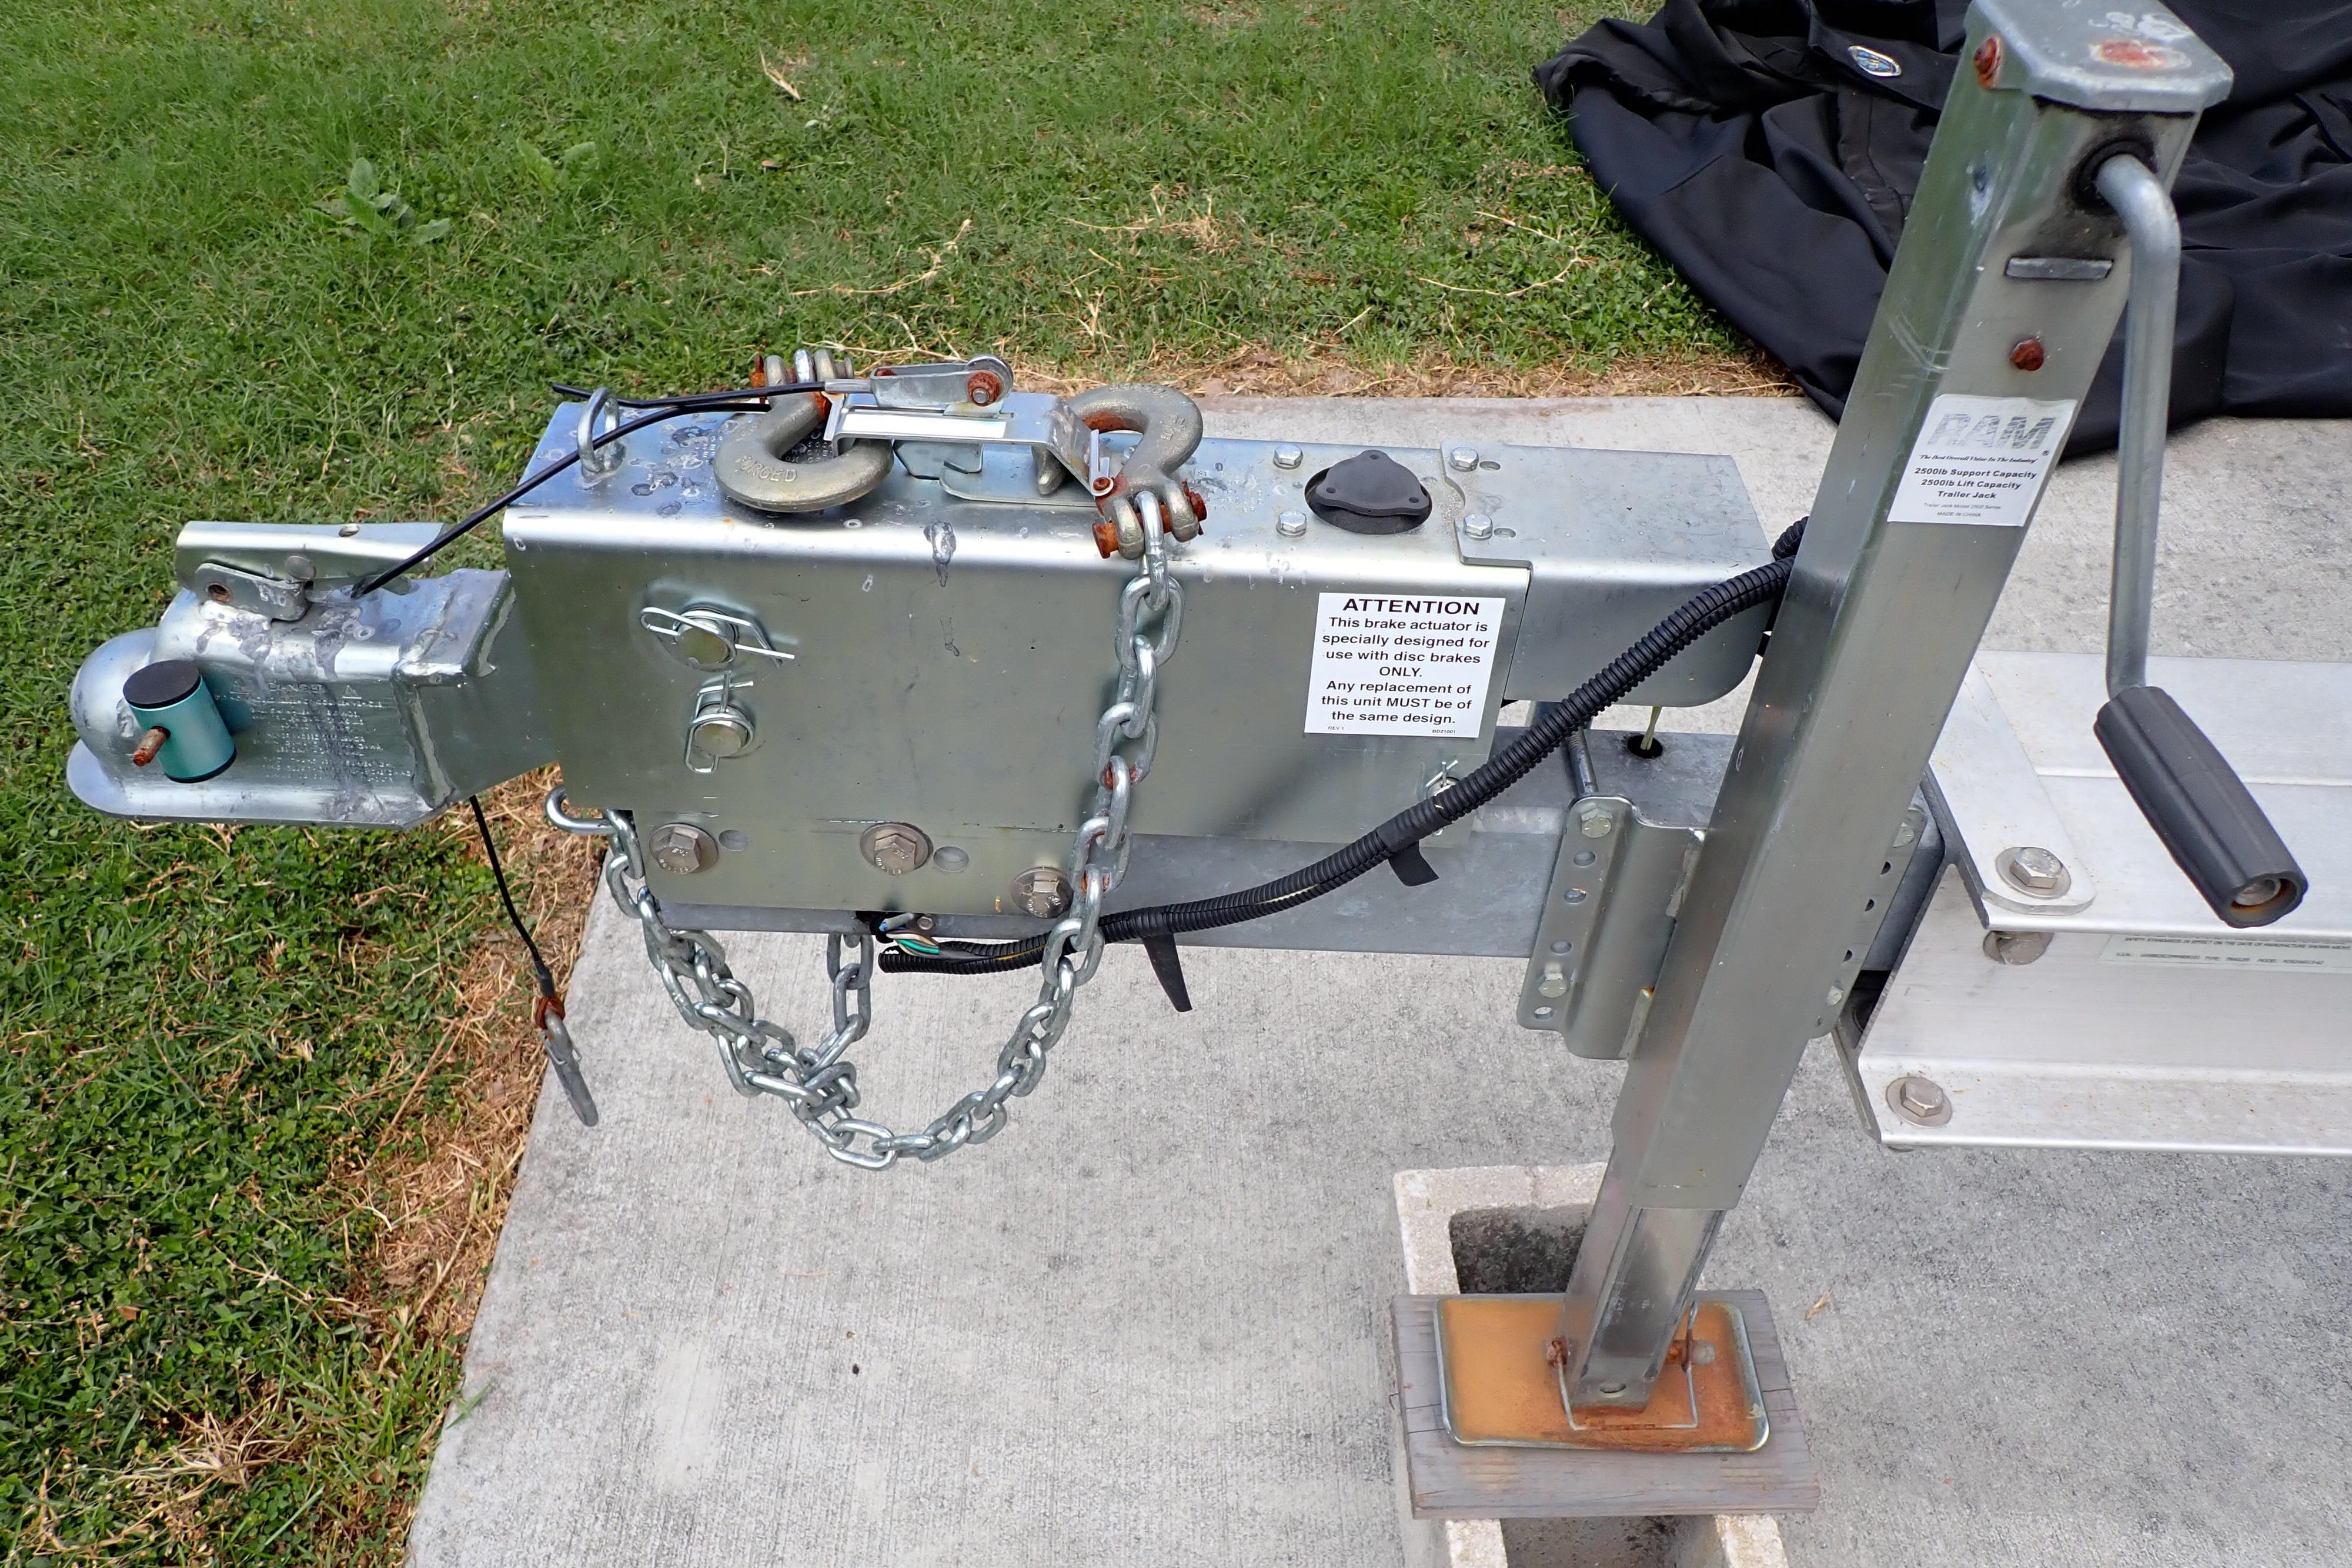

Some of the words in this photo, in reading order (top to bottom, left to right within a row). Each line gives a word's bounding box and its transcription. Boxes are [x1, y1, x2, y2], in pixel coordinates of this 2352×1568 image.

[1915, 467, 1947, 476] 2500lb
[1950, 469, 1990, 477] Support
[1993, 470, 2037, 480] Capacity
[1920, 479, 1955, 487] 2500lb
[1977, 481, 2022, 490] Capacity
[1342, 598, 1480, 616] ATTENTION
[1329, 617, 1360, 628] This
[1364, 618, 1406, 630] brake
[1410, 620, 1472, 632] actuator
[1475, 621, 1488, 632] is
[1322, 634, 1389, 647] specially
[1394, 636, 1464, 649] designed
[1469, 637, 1490, 648] for
[1326, 651, 1354, 660] use
[1358, 650, 1389, 661] with
[1394, 651, 1426, 662] disc
[1431, 653, 1481, 664] brakes
[1379, 666, 1423, 677] ONLY.
[1326, 680, 1355, 693] Any
[1359, 682, 1452, 696] replacement
[1456, 684, 1472, 694] of
[1321, 696, 1348, 706] this
[1354, 696, 1382, 707] unit
[1386, 698, 1431, 708] MUST
[1434, 699, 1452, 709] be
[1456, 700, 1472, 710] of
[1331, 711, 1355, 721] the
[1359, 713, 1399, 722] same
[1403, 713, 1456, 725] design.
